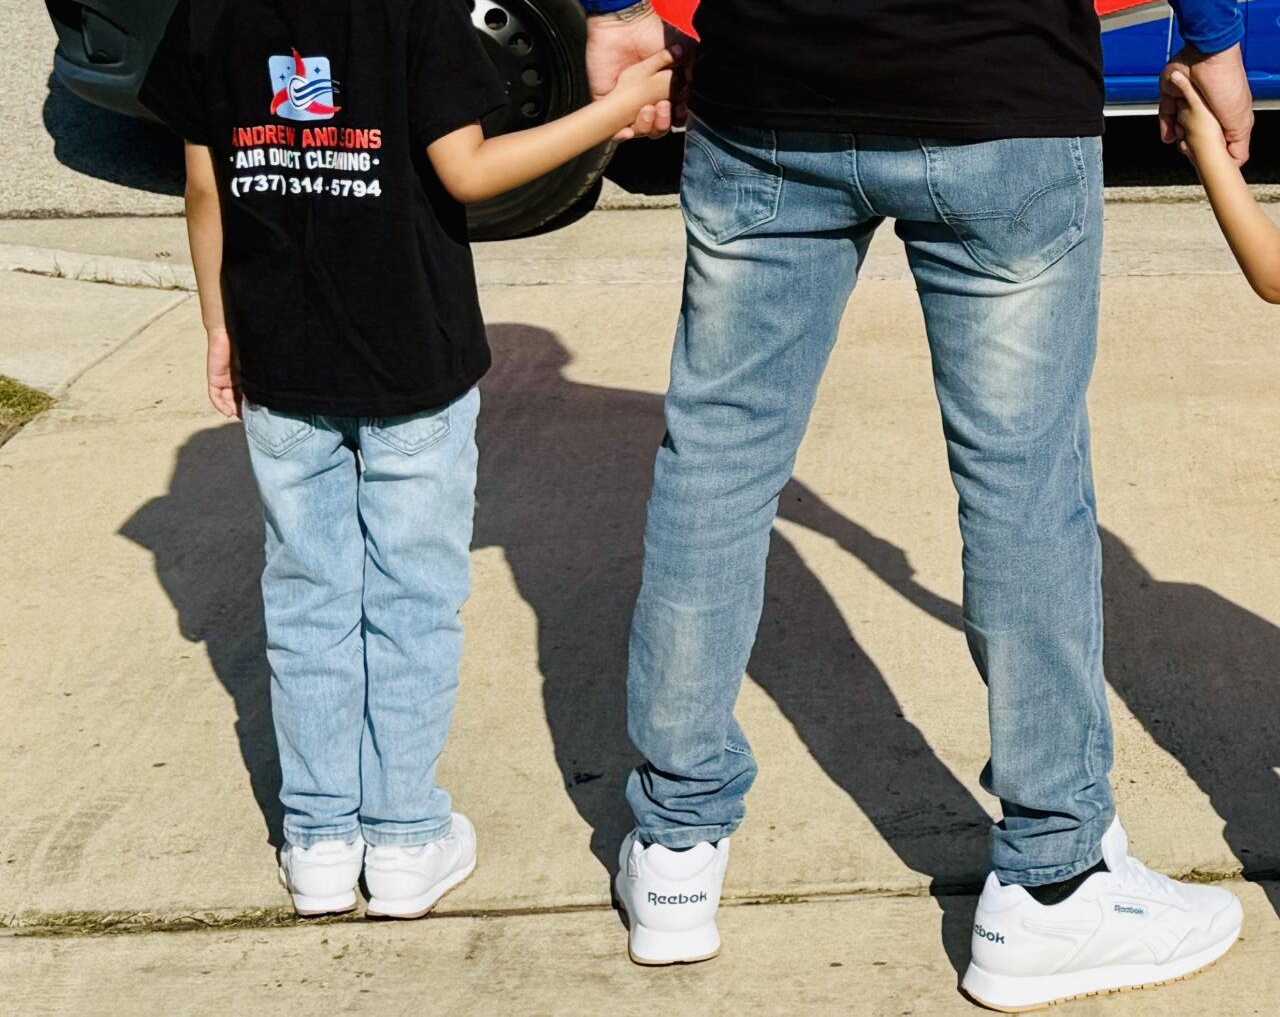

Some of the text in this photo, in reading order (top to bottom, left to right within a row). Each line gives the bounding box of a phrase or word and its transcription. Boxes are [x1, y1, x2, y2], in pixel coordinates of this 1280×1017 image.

[232, 124, 296, 147] ANDREW
[301, 126, 338, 148] AND
[235, 148, 266, 169] AIR
[269, 148, 301, 170] DUCT
[231, 174, 287, 198] (737)
[647, 890, 707, 906] Reebok
